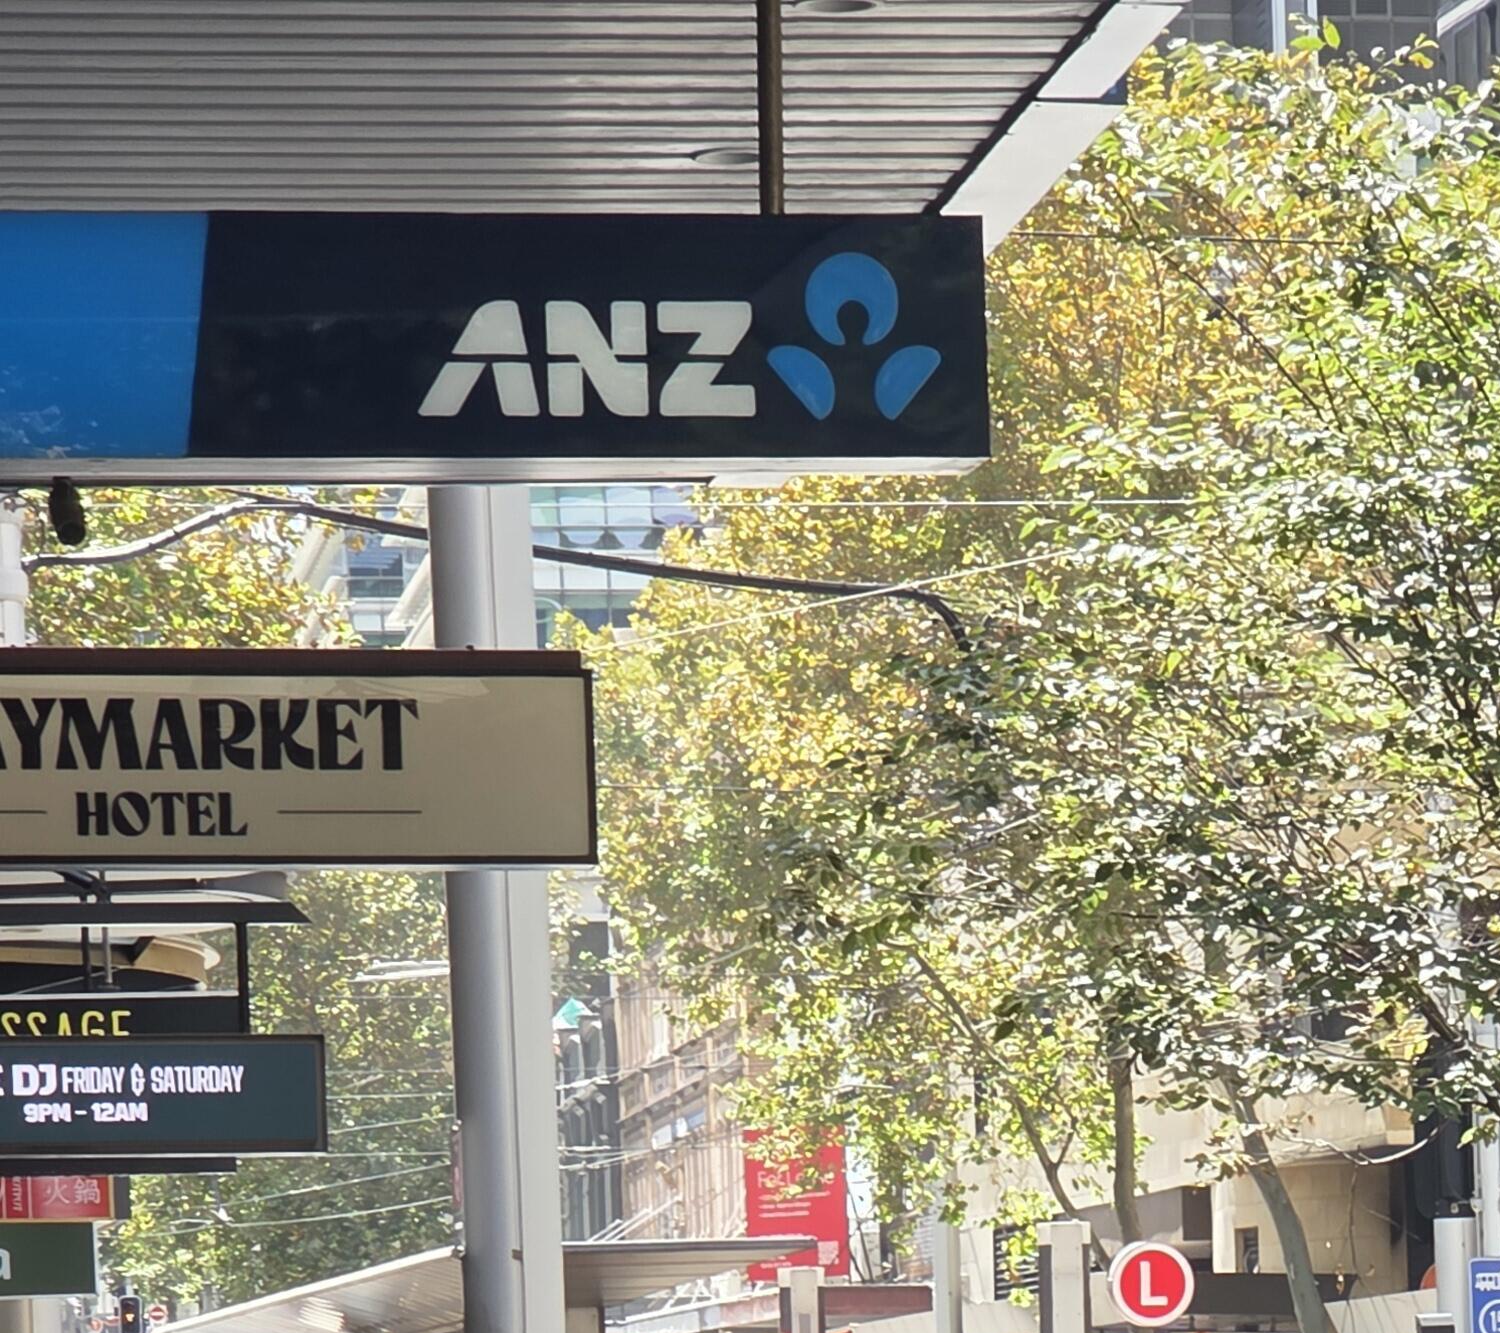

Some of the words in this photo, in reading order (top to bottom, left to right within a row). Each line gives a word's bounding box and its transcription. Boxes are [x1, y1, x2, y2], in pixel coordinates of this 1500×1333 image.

[418, 300, 757, 417] ANZ
[0, 697, 419, 771] YMARKET
[75, 791, 249, 837] HOTEL
[12, 1064, 57, 1096] DJ
[61, 1066, 125, 1094] FRIDAY
[150, 1065, 244, 1093] SATURDAY
[23, 1102, 72, 1123] 9PM
[91, 1102, 149, 1122] 12AM
[43, 1178, 101, 1205] 火鍋
[1139, 1260, 1169, 1307] L
